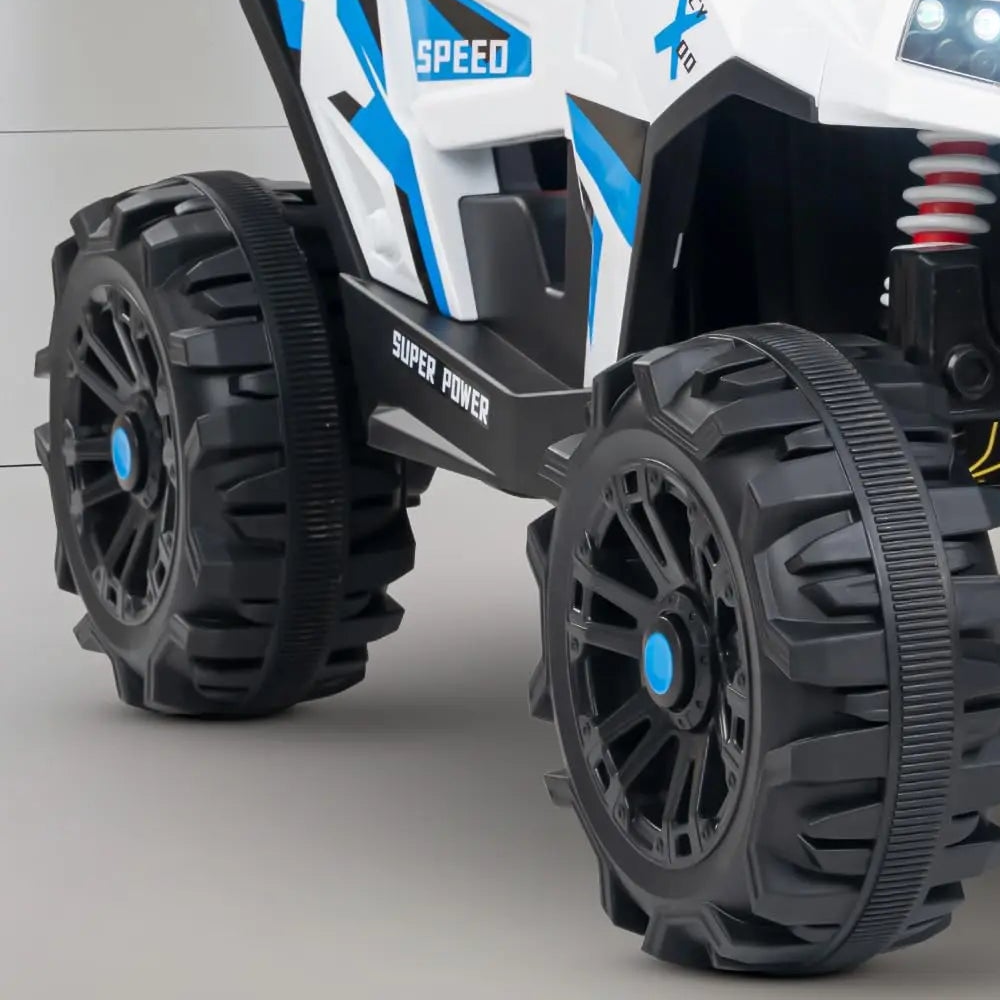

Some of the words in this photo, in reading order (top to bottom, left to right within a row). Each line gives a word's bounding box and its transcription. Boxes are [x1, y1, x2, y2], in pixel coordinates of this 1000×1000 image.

[416, 39, 508, 73] SPEED
[392, 328, 436, 385] SUPER
[441, 366, 489, 426] POWER
